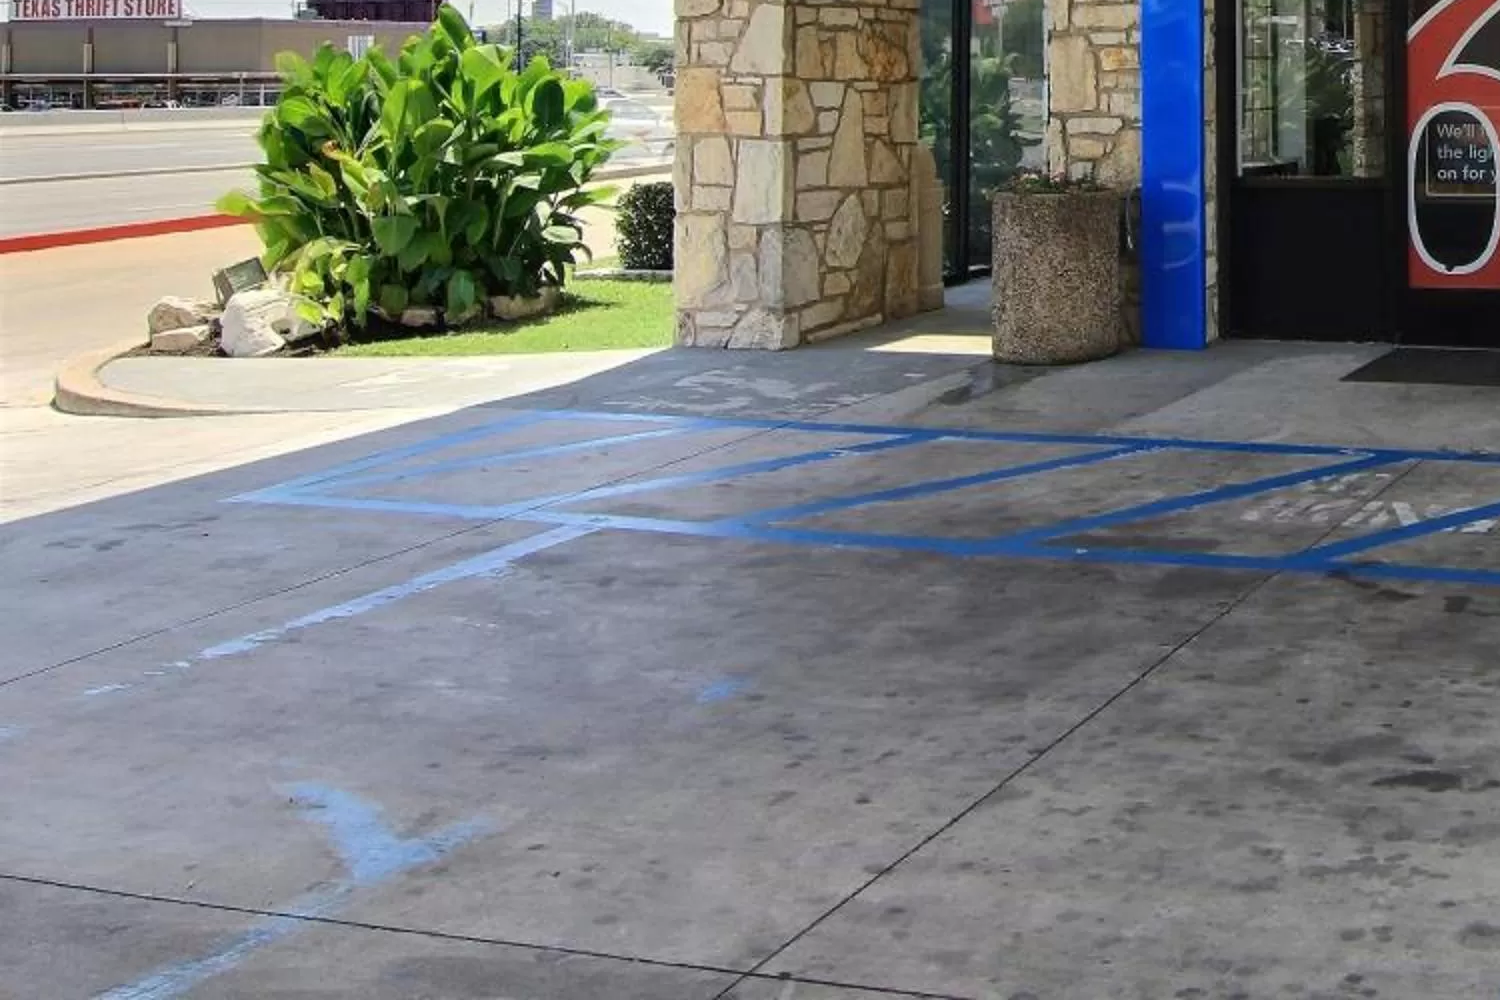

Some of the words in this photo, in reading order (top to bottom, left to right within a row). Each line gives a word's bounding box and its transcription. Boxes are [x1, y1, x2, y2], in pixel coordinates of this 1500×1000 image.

[13, 0, 61, 17] TEXAS
[1436, 123, 1475, 138] We'll
[1437, 144, 1463, 159] the
[1468, 144, 1497, 163] lig
[1437, 168, 1457, 180] on
[1462, 164, 1484, 180] for
